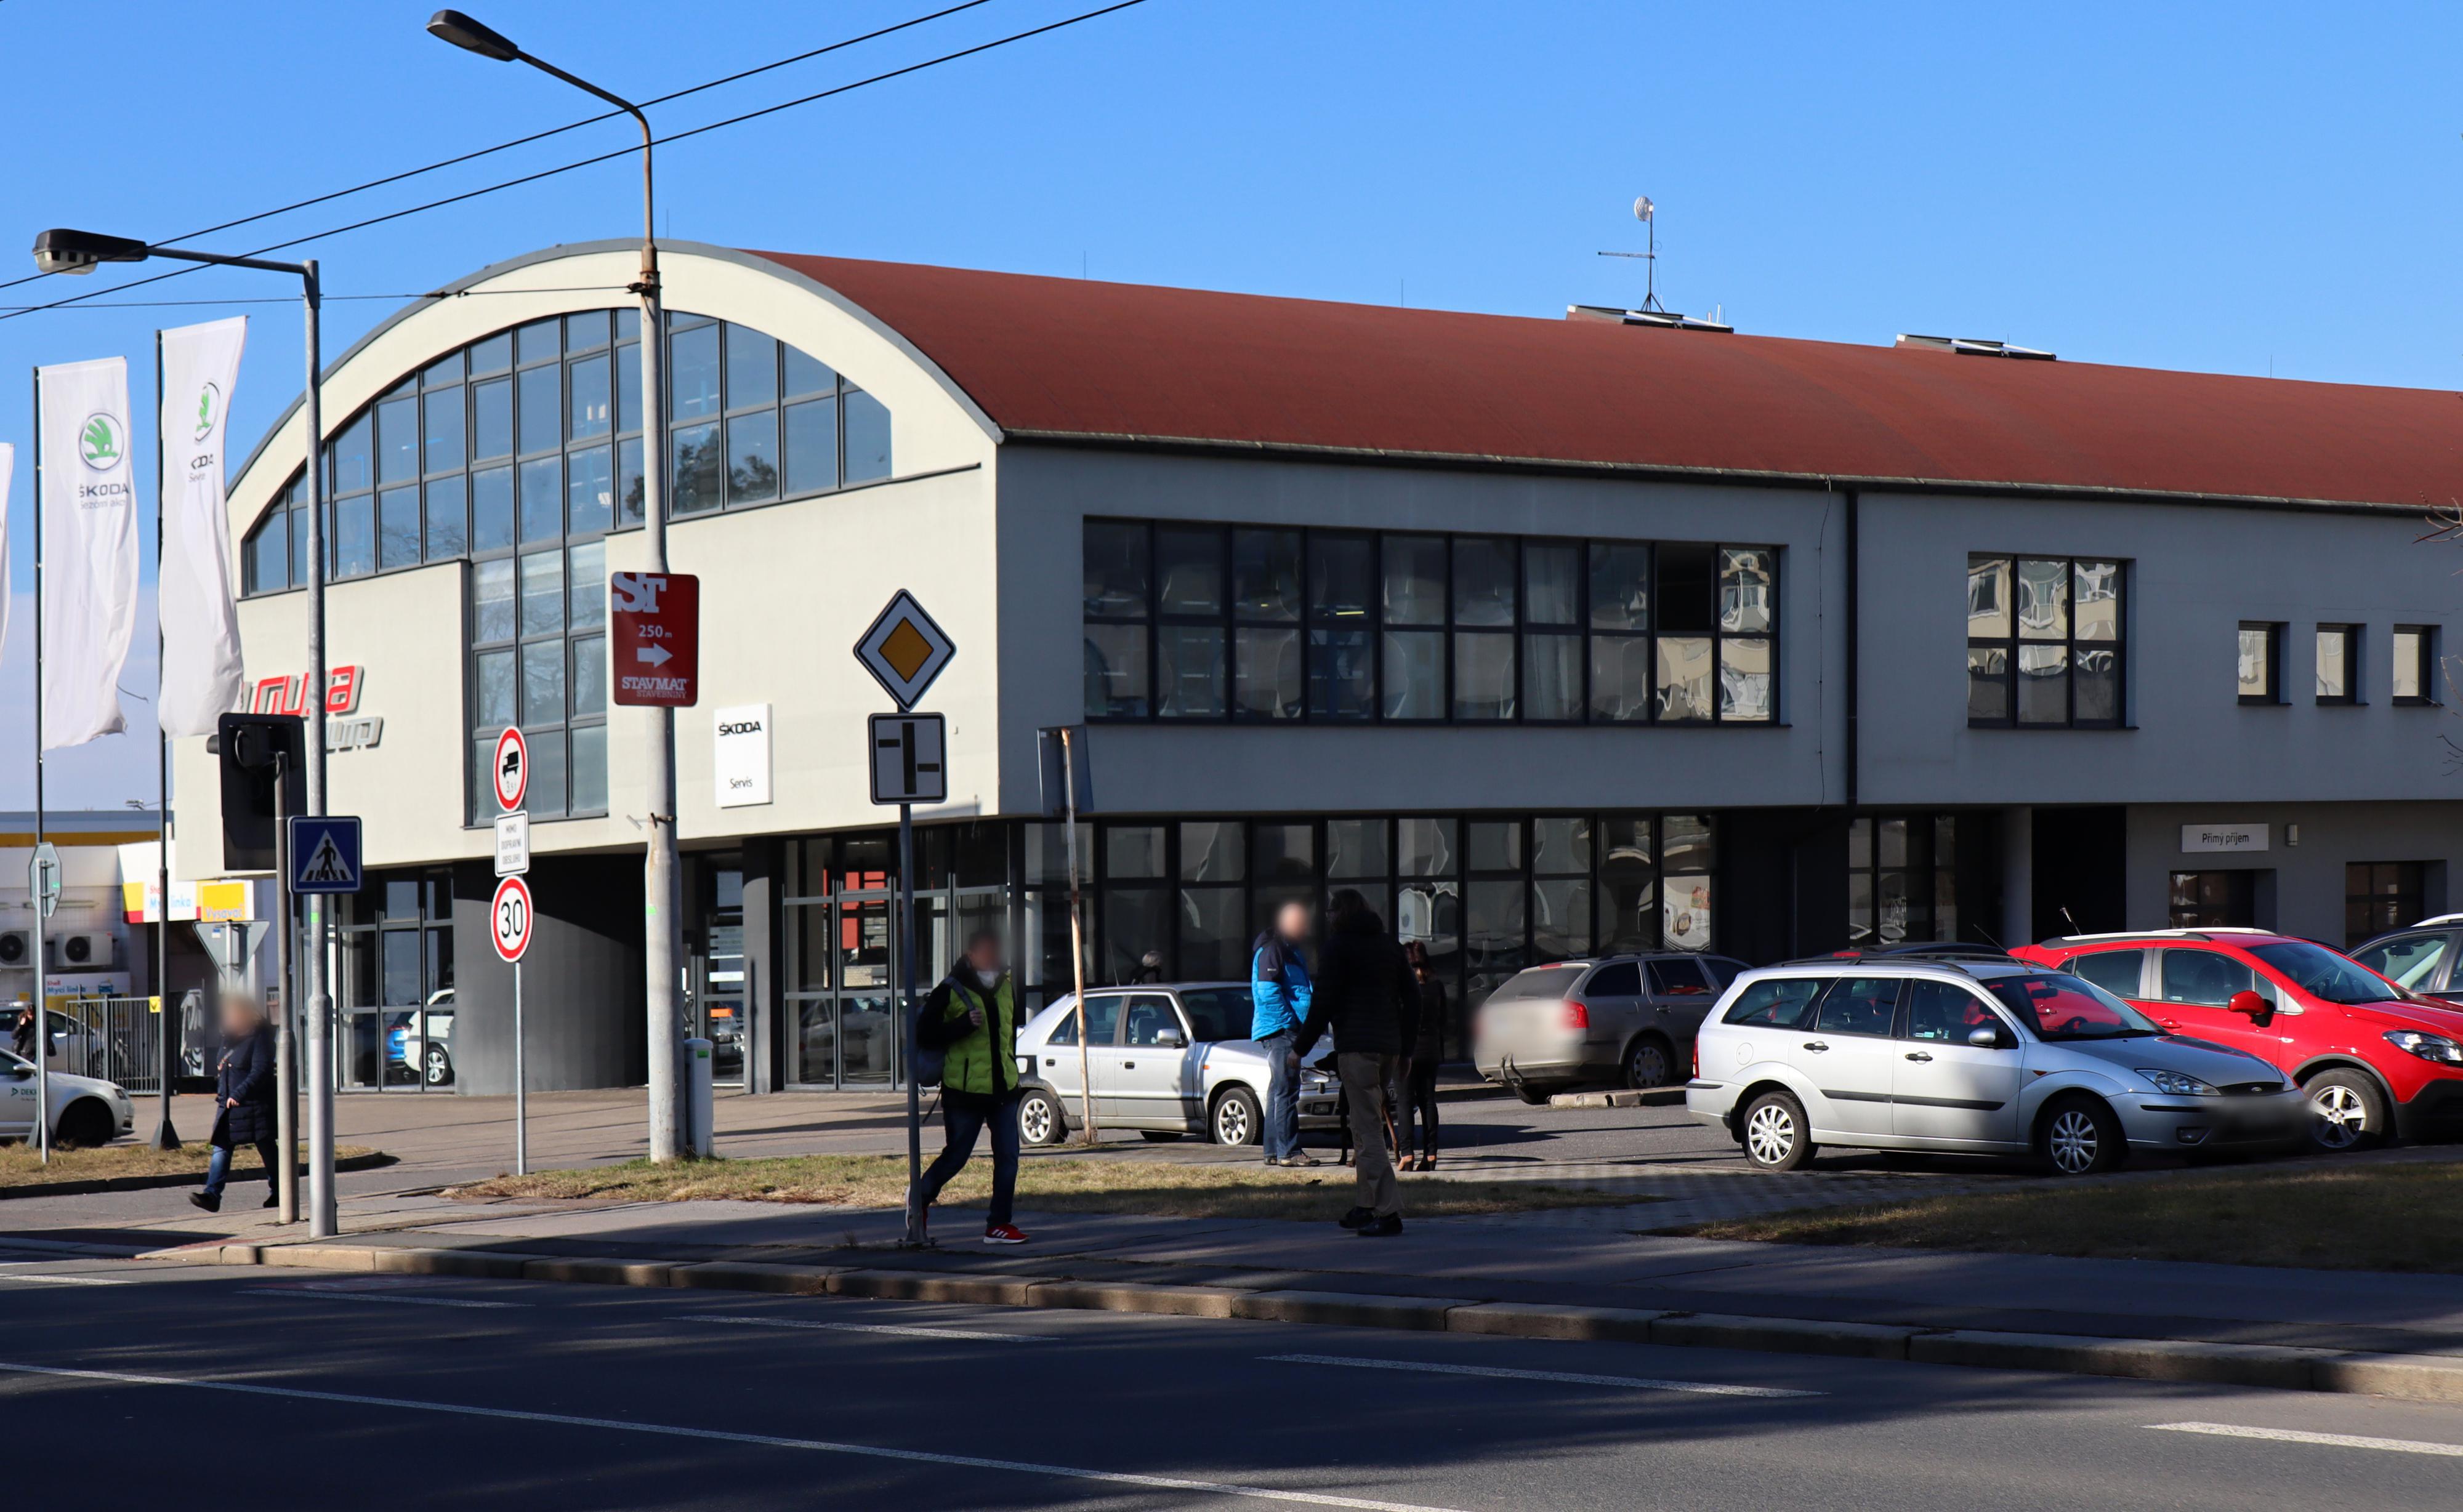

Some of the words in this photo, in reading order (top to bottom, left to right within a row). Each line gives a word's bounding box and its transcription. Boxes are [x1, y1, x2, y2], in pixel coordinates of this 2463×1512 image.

[612, 573, 667, 613] ST
[638, 625, 663, 638] 250
[622, 676, 687, 691] STAVMAT
[719, 720, 762, 737] ŠKODA
[730, 776, 752, 789] Servis
[501, 899, 523, 939] 30
